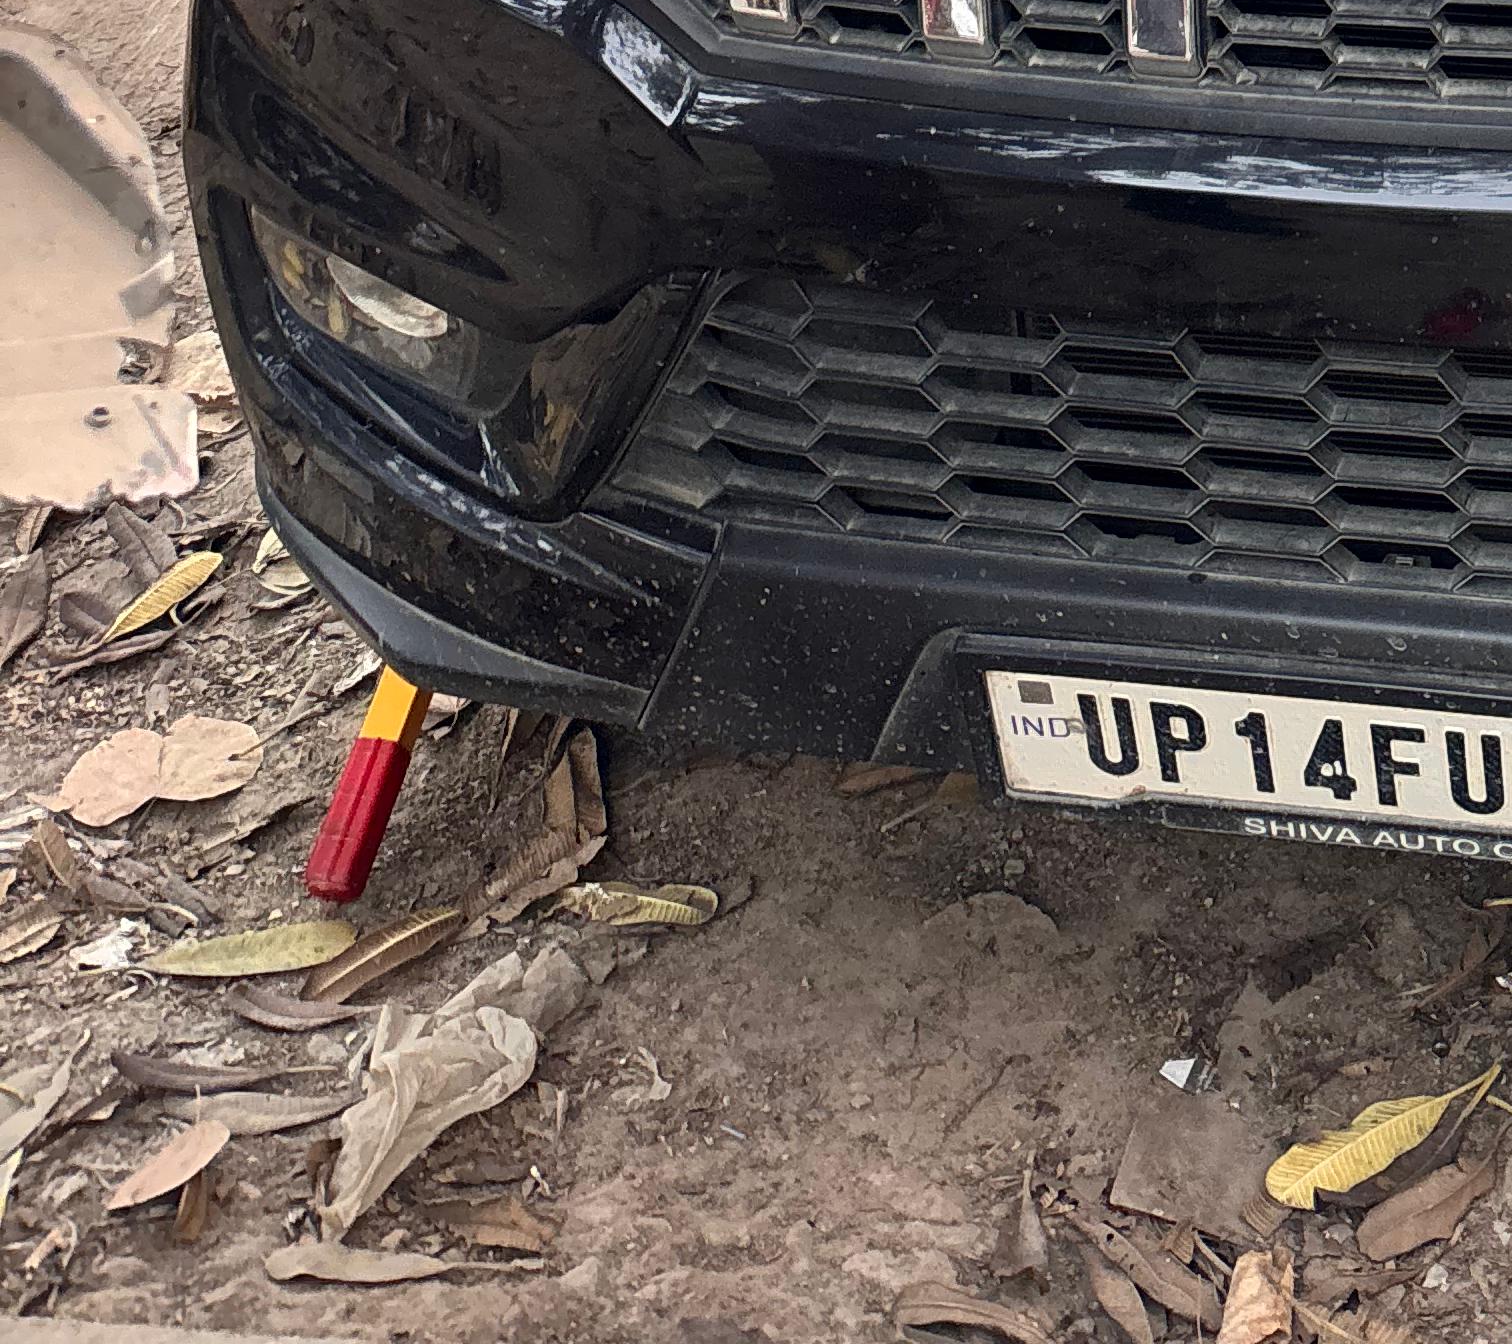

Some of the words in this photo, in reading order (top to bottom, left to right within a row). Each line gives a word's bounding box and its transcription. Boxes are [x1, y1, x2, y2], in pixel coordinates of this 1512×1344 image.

[1009, 713, 1072, 741] IND
[1243, 816, 1361, 846] SHIVA
[1373, 827, 1481, 859] AUTO
